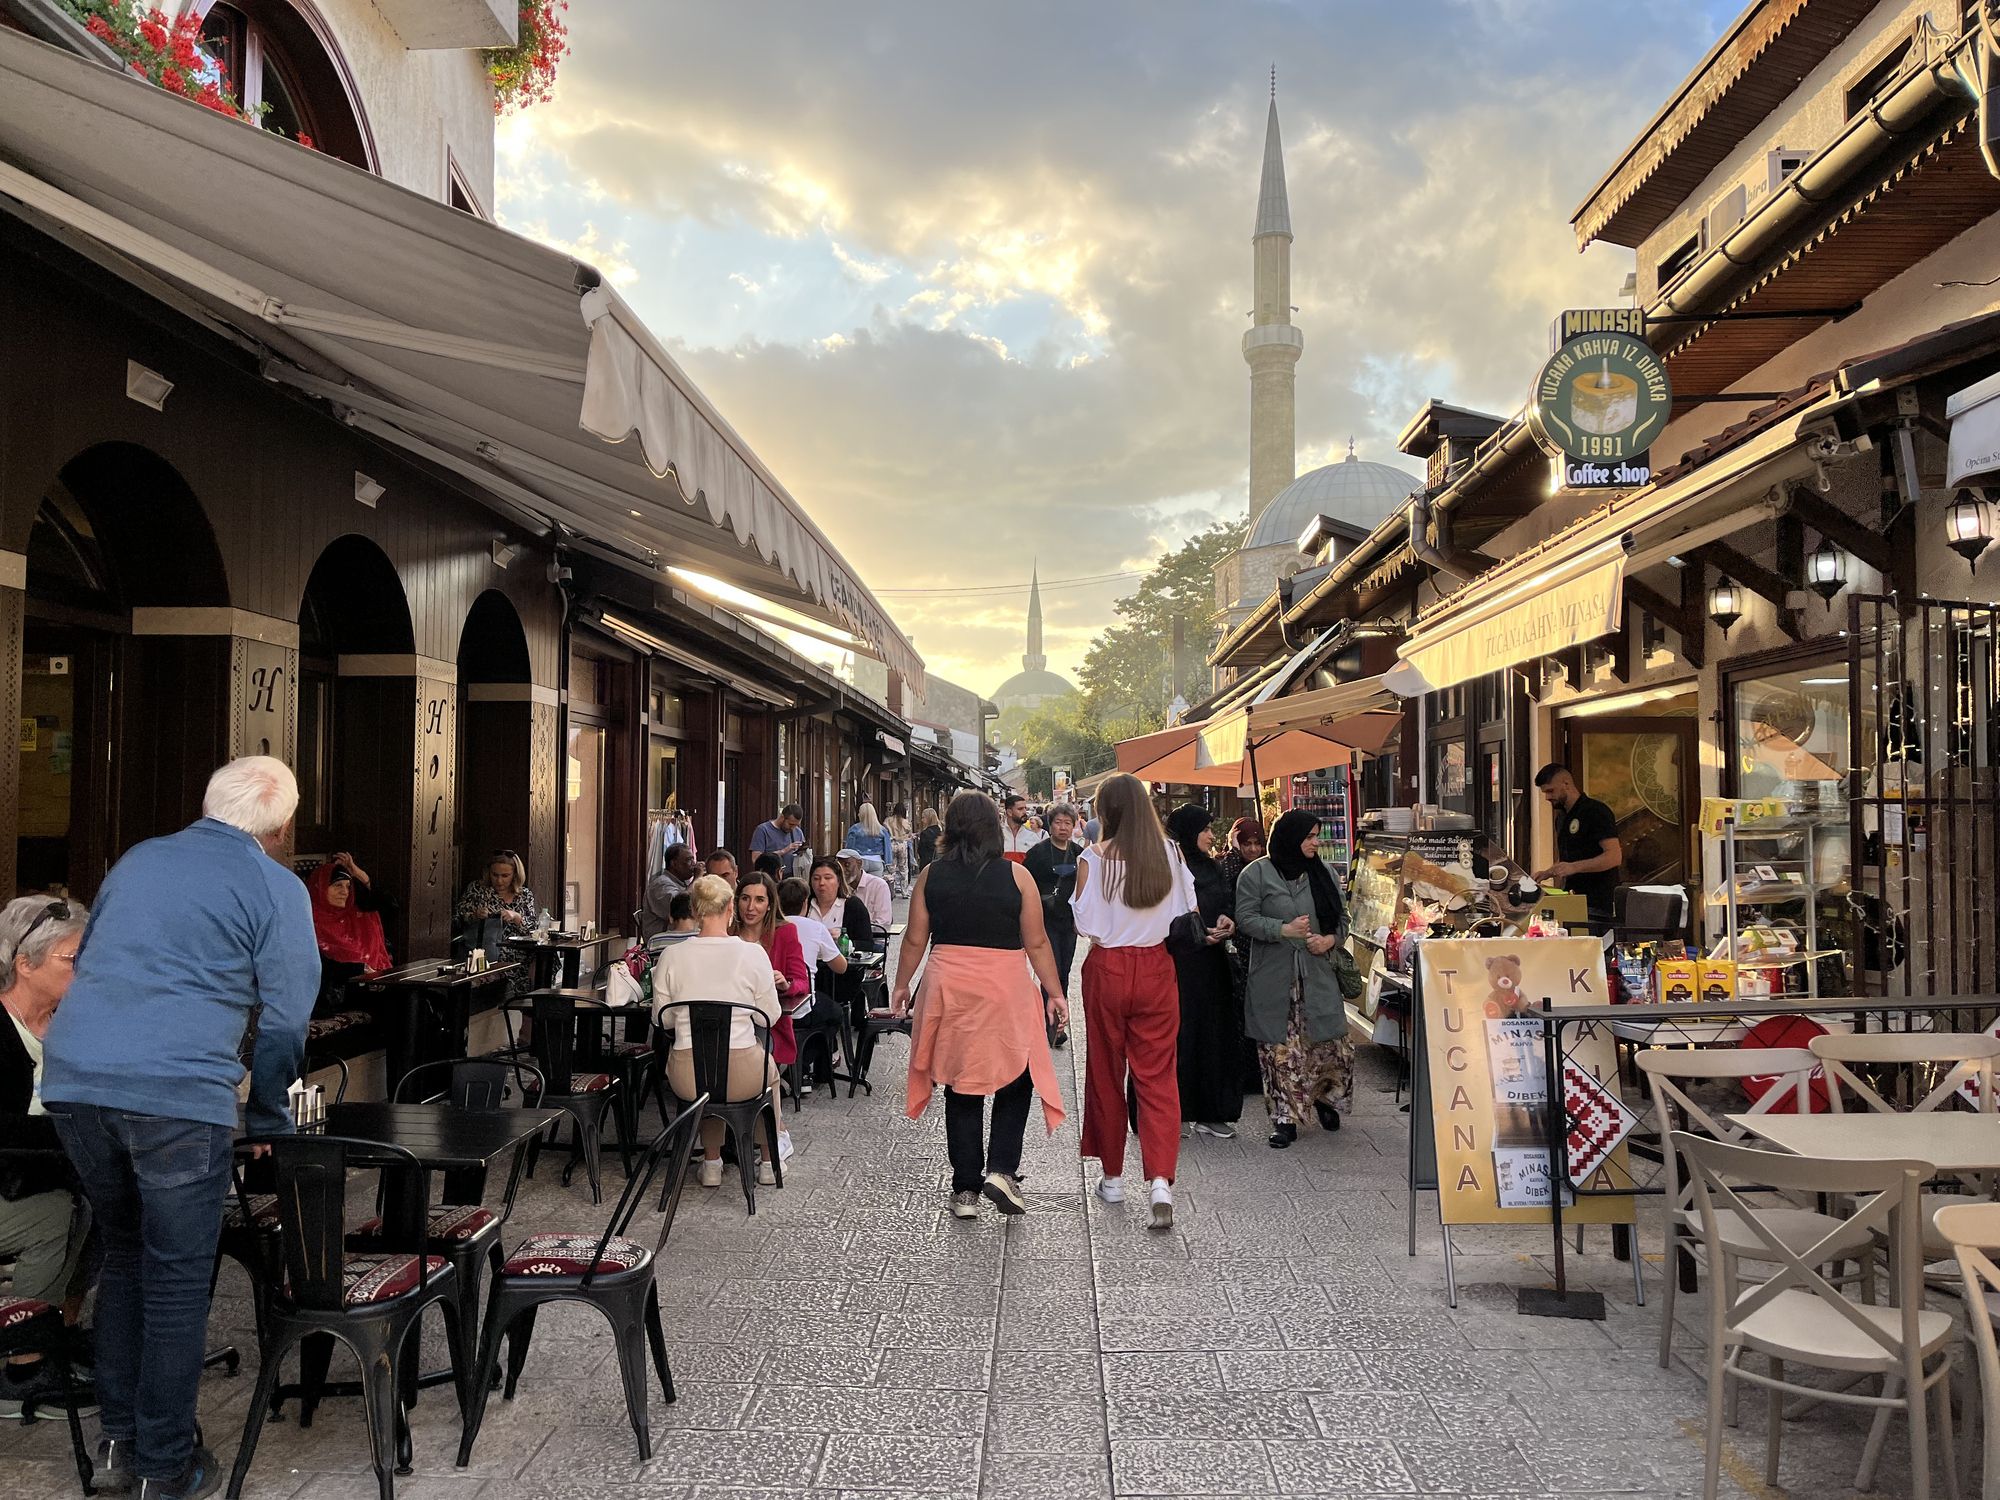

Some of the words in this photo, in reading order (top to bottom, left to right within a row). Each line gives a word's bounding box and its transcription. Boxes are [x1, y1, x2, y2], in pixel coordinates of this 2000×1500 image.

[1565, 309, 1643, 337] MINASA
[1541, 353, 1574, 401] TUCANA
[1573, 339, 1619, 360] KAHVA
[1622, 344, 1638, 361] IZ
[1636, 355, 1666, 401] DIBEKA
[1581, 437, 1622, 456] 1991
[1566, 463, 1608, 484] Coffee
[1613, 461, 1649, 485] shop
[1560, 592, 1606, 627] MINASA
[1438, 970, 1482, 1191] TUCANA
[1507, 1090, 1547, 1101] DIBEK
[1525, 1185, 1550, 1197] DIBEK
